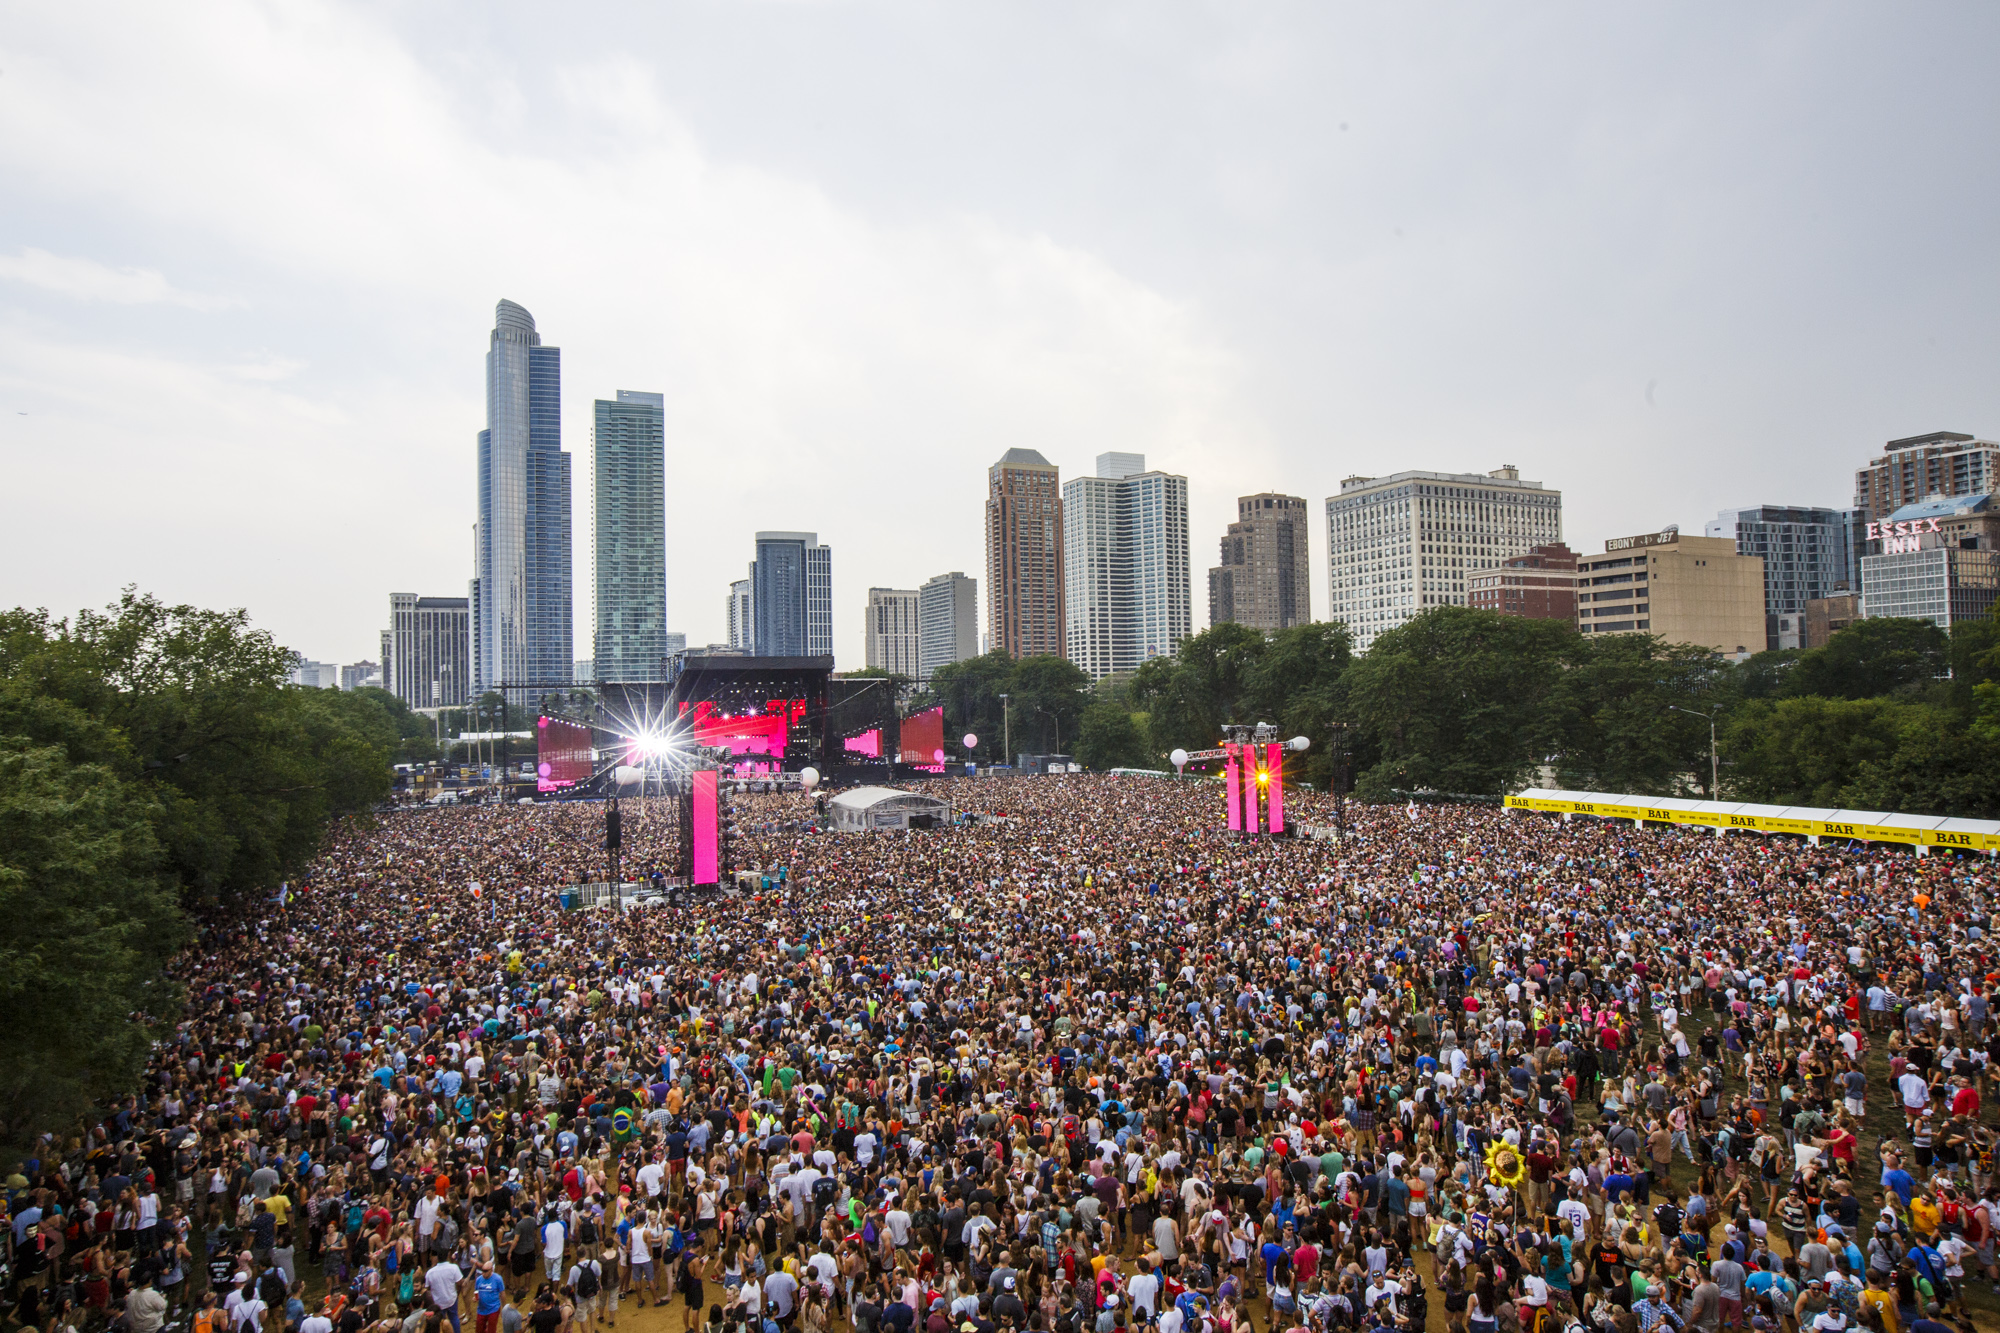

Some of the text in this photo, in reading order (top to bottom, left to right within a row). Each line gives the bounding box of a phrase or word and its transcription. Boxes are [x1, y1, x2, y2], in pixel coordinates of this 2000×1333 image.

[1865, 517, 1942, 541] ESSEX
[1608, 536, 1635, 551] EBONY
[1657, 531, 1674, 544] JET
[1884, 535, 1921, 555] INN
[1511, 798, 1529, 807] BAR
[1574, 803, 1594, 812] BAR
[1648, 809, 1671, 819] BAR
[1730, 816, 1756, 826] BAR
[1824, 824, 1855, 835] BAR
[1935, 832, 1972, 845] BAR
[1569, 1212, 1581, 1228] 13
[1472, 1224, 1484, 1241] 32
[1875, 1300, 1884, 1314] 2
